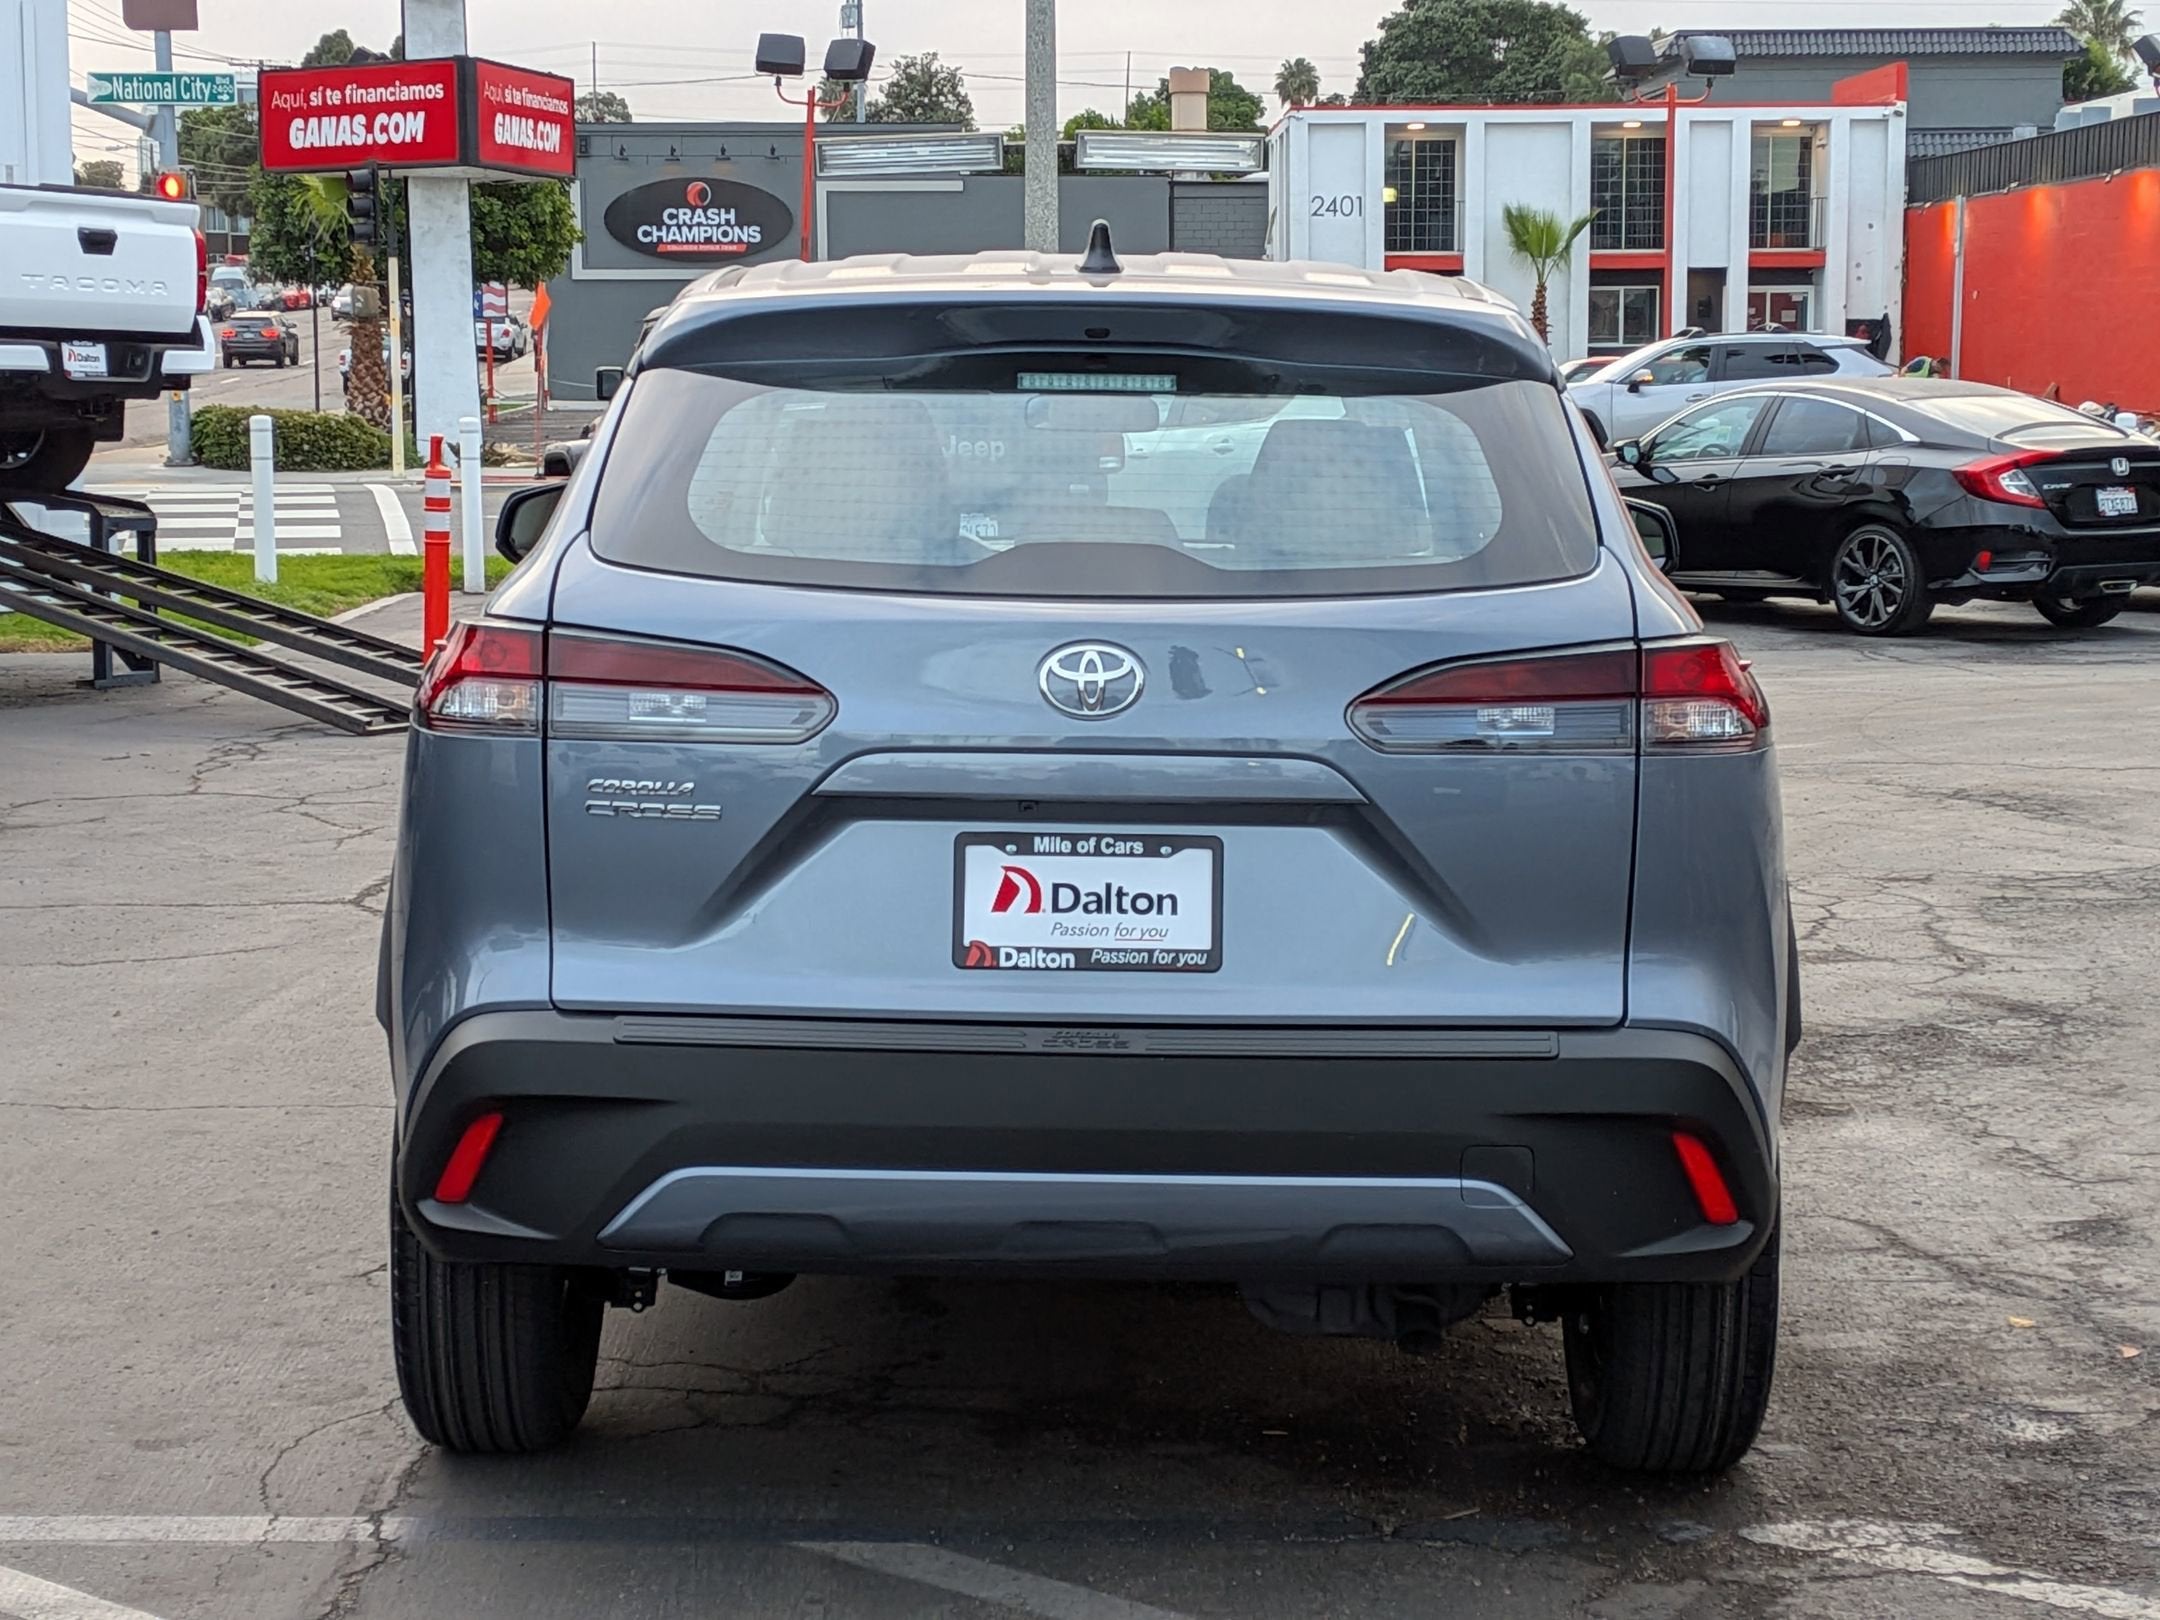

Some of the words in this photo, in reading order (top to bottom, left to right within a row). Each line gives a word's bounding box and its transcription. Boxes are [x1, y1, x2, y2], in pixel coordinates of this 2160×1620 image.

[112, 76, 176, 100] National
[180, 76, 211, 102] City
[325, 88, 342, 105] te
[345, 80, 444, 104] financiamos
[289, 111, 426, 150] GANAS.COM
[494, 112, 561, 154] GANAS.COM
[662, 208, 735, 226] CRASH
[1311, 195, 1363, 217] 2401
[637, 225, 762, 243] CHAMPIONS
[21, 273, 168, 296] TACOMA
[942, 435, 1005, 462] Jeep
[587, 778, 695, 796] COROLLA
[584, 800, 722, 820] CROSS
[1034, 836, 1072, 854] Mile
[1077, 837, 1097, 854] of
[1101, 838, 1144, 855] Cars
[1051, 882, 1178, 916] Dalton
[1050, 922, 1109, 938] Passion
[1114, 922, 1137, 938] for
[1139, 926, 1169, 941] you
[1000, 947, 1076, 969] Dalton
[1091, 949, 1150, 964] Passion
[1151, 950, 1174, 966] for
[1175, 954, 1207, 969] you
